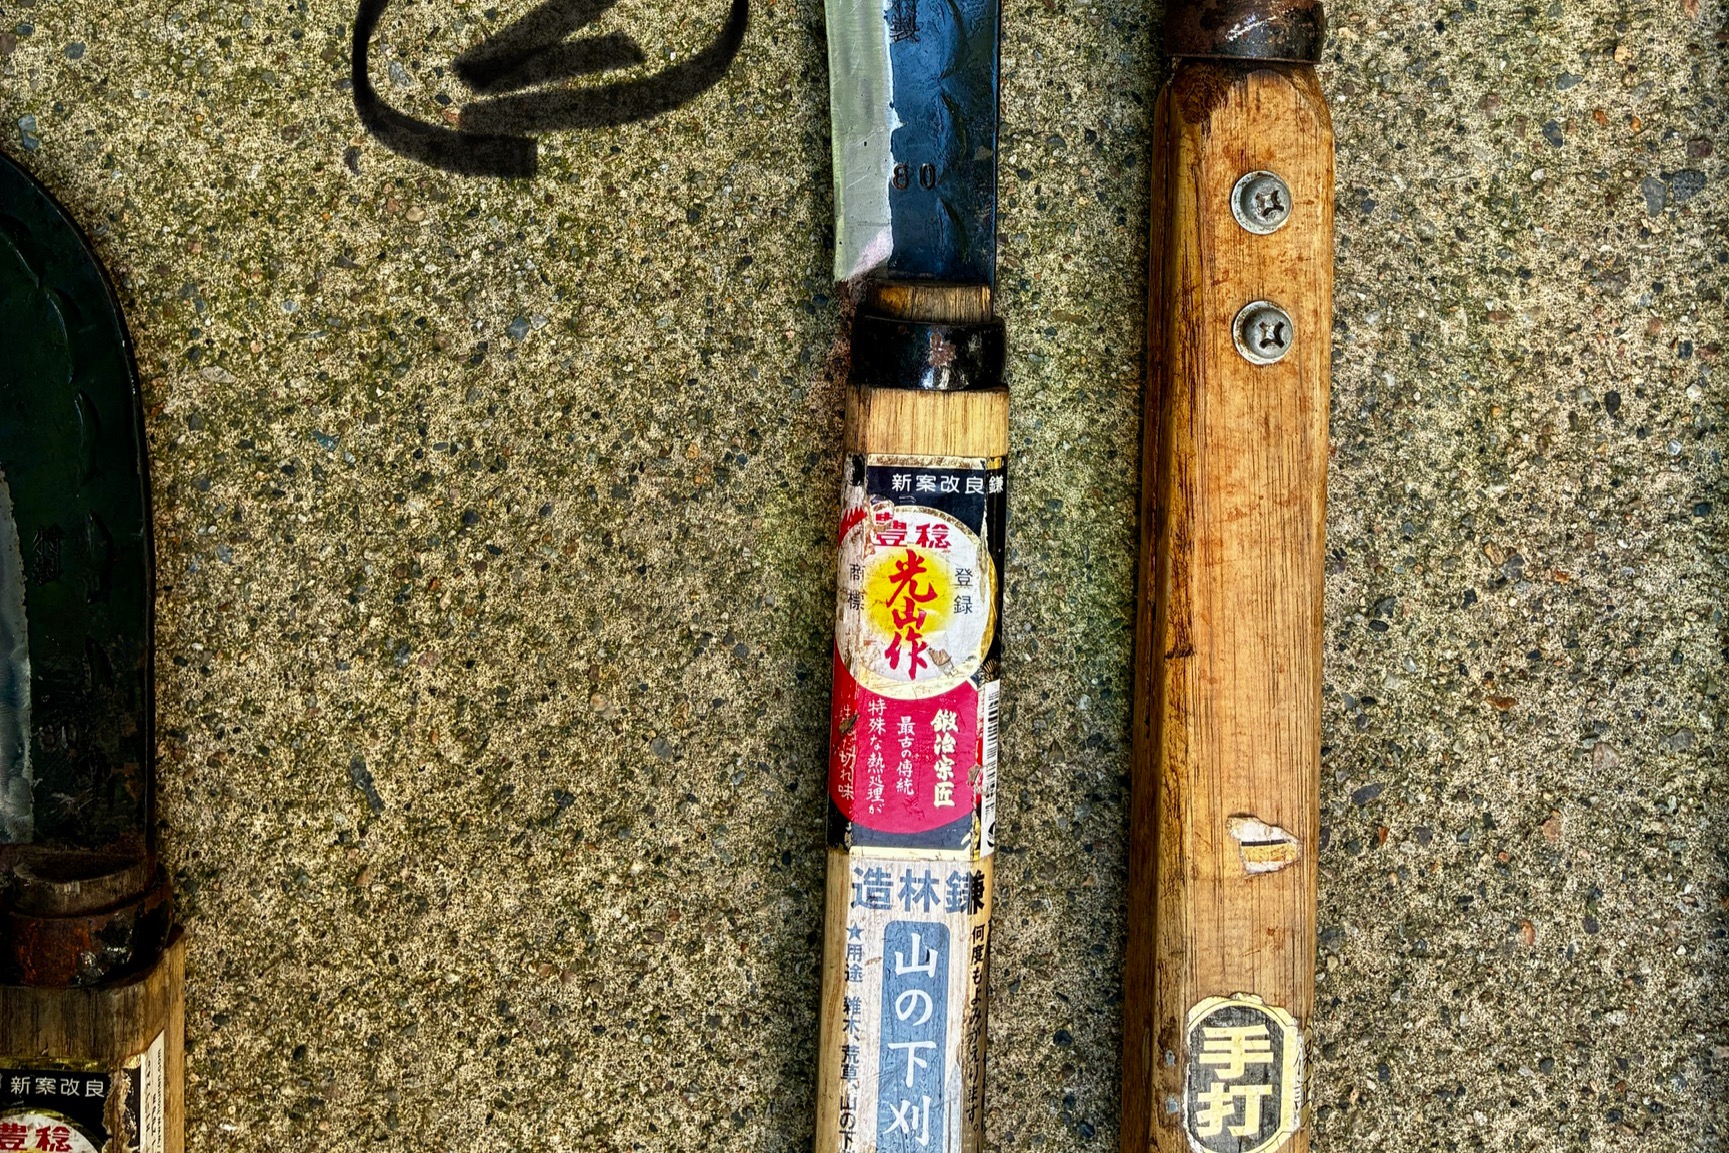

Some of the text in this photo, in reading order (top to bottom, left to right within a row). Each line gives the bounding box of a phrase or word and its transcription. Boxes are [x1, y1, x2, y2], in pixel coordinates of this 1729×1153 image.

[891, 473, 1004, 495] 新案改良鎌
[884, 548, 939, 681] 光山作
[953, 567, 974, 615] 登録
[866, 697, 888, 815] 特殊な熱処理が
[850, 866, 986, 916] 造林鎌
[882, 932, 938, 1147] 山の下刈
[10, 1075, 105, 1098] 新案改良
[1195, 1024, 1274, 1138] 手打
